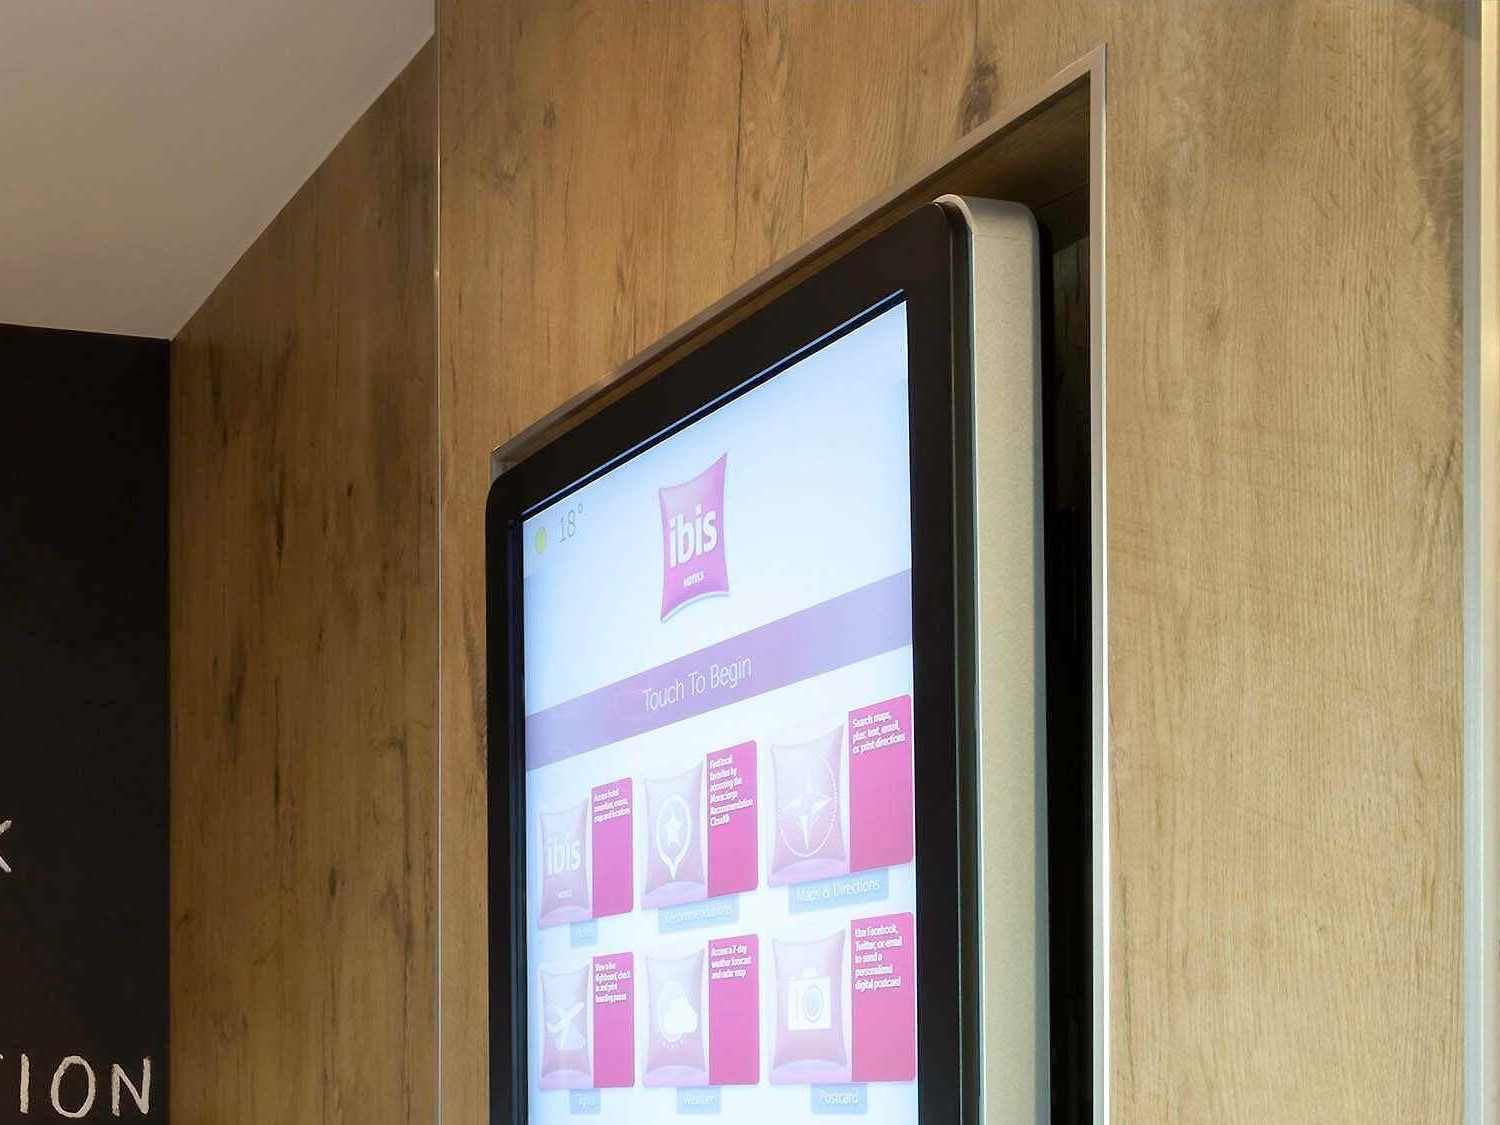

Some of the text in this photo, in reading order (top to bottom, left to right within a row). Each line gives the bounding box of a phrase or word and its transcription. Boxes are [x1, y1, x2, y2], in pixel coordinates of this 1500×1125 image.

[669, 504, 718, 568] ibis
[642, 656, 752, 712] Touch To Begin
[547, 832, 581, 876] ibis
[833, 878, 880, 897] Directions
[819, 1089, 859, 1105] Postcard
